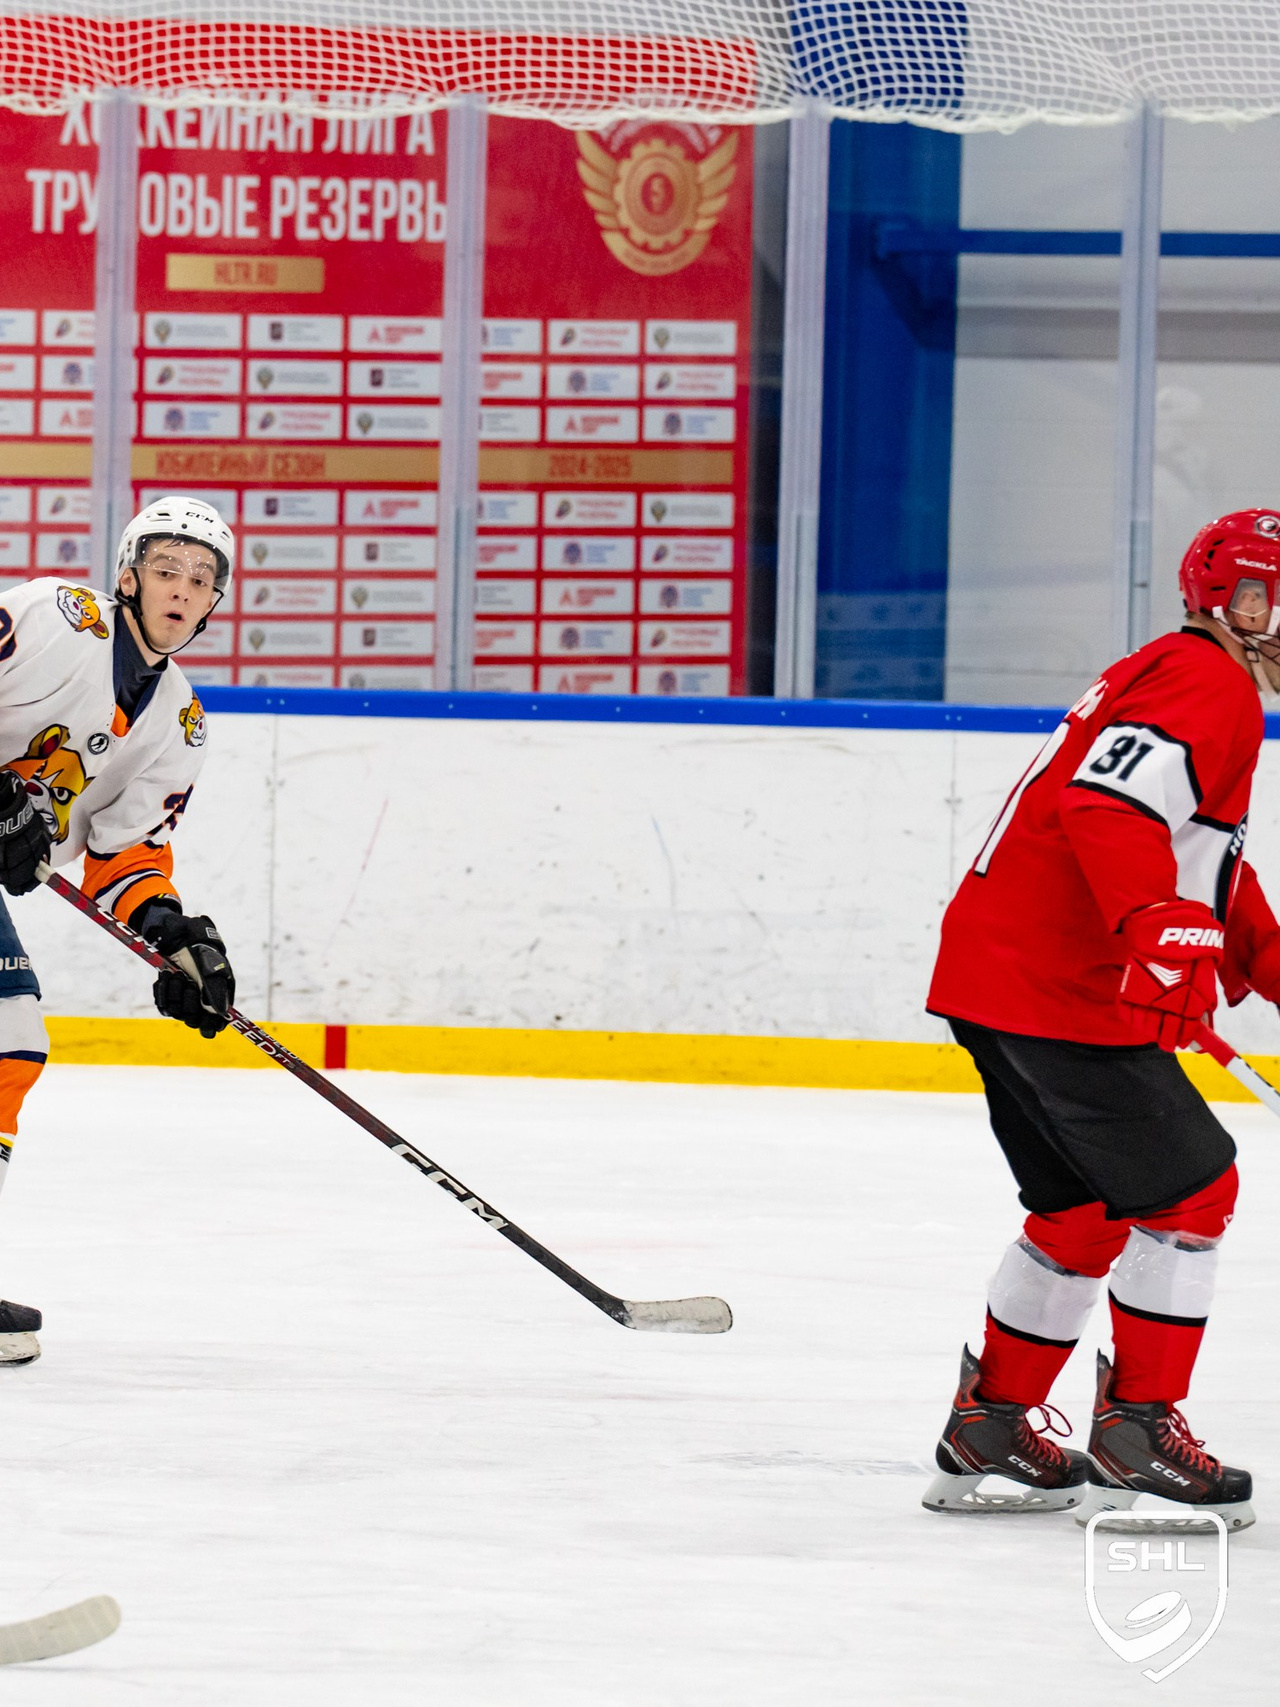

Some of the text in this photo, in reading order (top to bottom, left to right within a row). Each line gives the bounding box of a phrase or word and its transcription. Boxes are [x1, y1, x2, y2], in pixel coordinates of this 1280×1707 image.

[60, 86, 435, 155] ХКЕЙНАЯ ЛИГА
[26, 169, 260, 239] ТРУОВЫЕ
[391, 1143, 509, 1230] CCM
[1007, 1454, 1043, 1477] CCM
[1150, 1461, 1192, 1486] CCM
